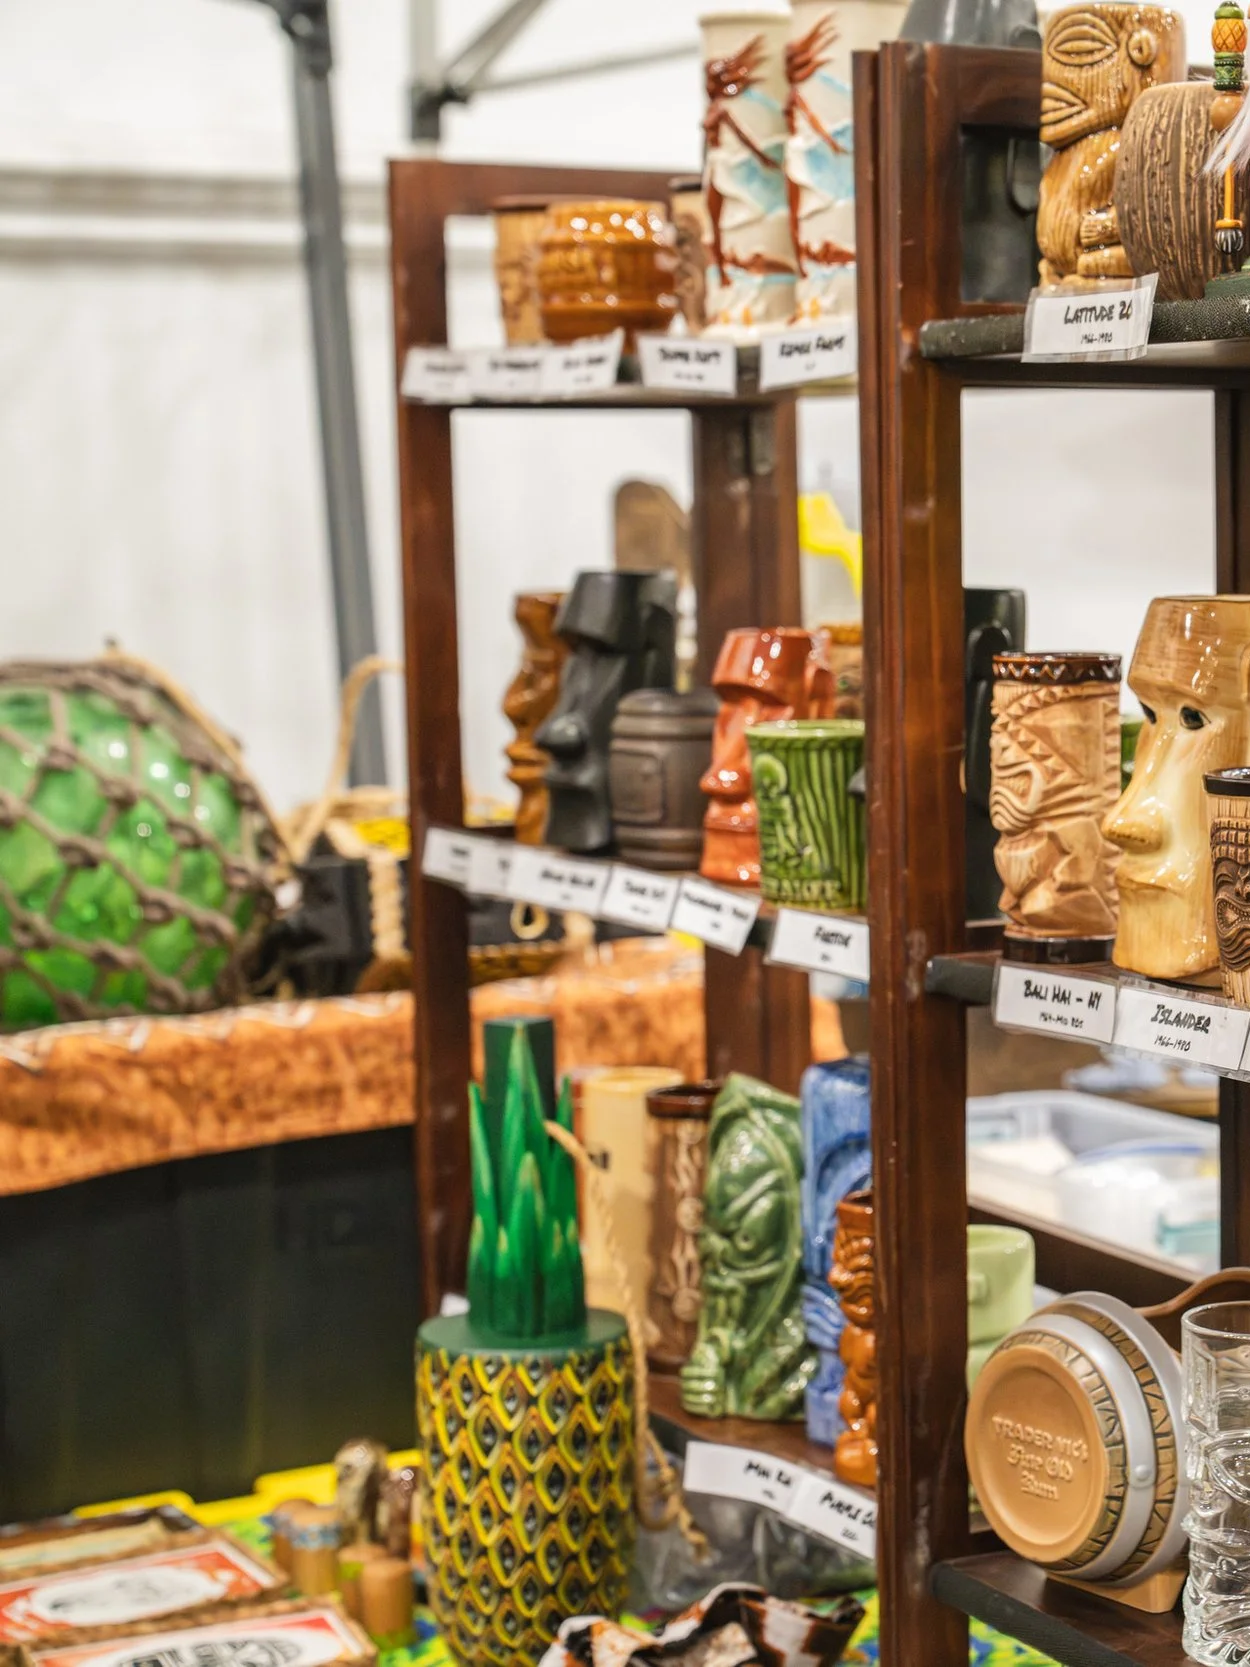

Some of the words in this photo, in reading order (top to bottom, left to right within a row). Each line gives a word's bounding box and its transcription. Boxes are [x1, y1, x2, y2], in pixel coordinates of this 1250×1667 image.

[1064, 304, 1115, 325] LATITUDE
[1023, 979, 1049, 1001] BALI
[1051, 984, 1072, 1005] HAI
[1150, 1003, 1212, 1034] ISLANDER
[991, 1415, 1054, 1450] TRADER
